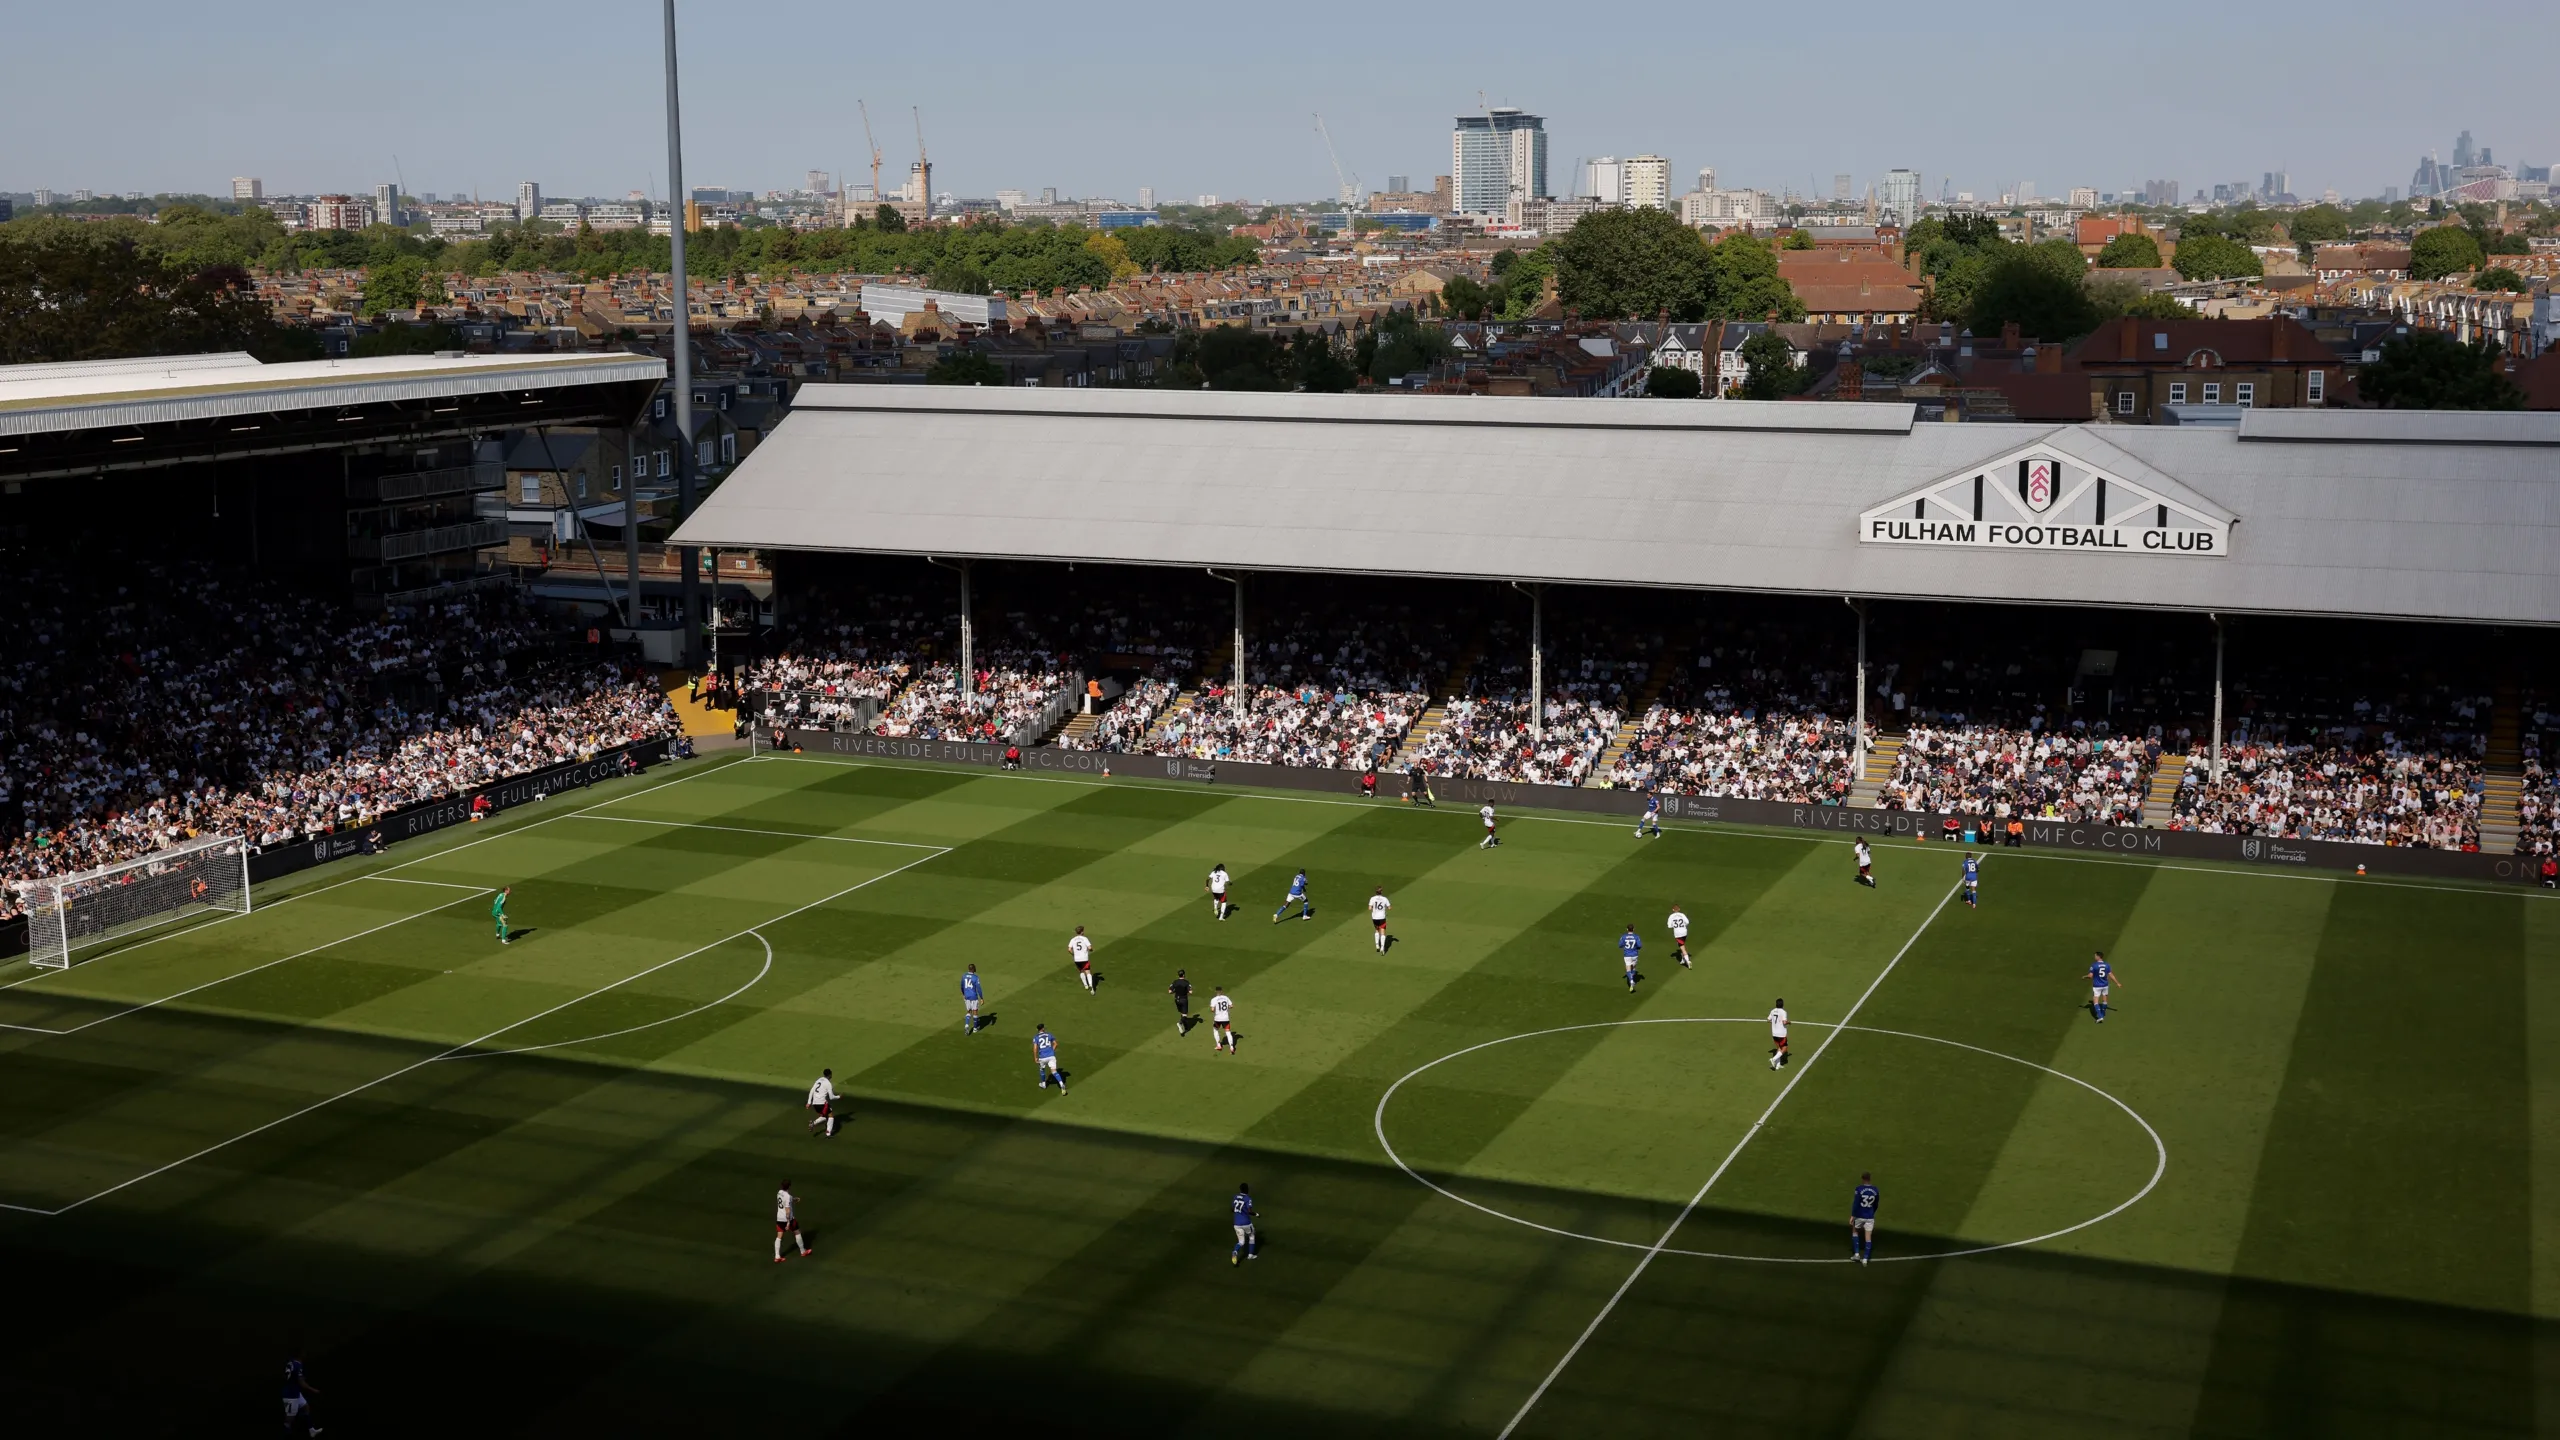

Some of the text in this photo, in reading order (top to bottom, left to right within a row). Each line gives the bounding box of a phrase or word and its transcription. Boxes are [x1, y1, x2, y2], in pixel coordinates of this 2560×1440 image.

[1872, 521, 2214, 551] FULHAM FOOTBALL CLUB
[1398, 779, 1449, 798] SE
[1465, 785, 1517, 801] NOW
[1688, 801, 1699, 809] the
[1688, 809, 1718, 817] riverside
[2271, 844, 2284, 852] the
[2270, 852, 2306, 861] riverside
[1968, 863, 1976, 872] 18
[2495, 860, 2537, 878] ON
[1215, 874, 1220, 883] 3
[1374, 902, 1383, 911] 16
[1673, 919, 1685, 929] 32
[1076, 942, 1083, 951] 5
[1625, 939, 1636, 949] 37
[2098, 968, 2106, 977] 5
[964, 979, 973, 989] 14
[1218, 1001, 1227, 1011] 18
[1773, 1014, 1779, 1024] 7
[1038, 1037, 1051, 1048] 24
[815, 1082, 821, 1093] 2
[1233, 1200, 1245, 1213] 27
[1860, 1195, 1875, 1208] 32
